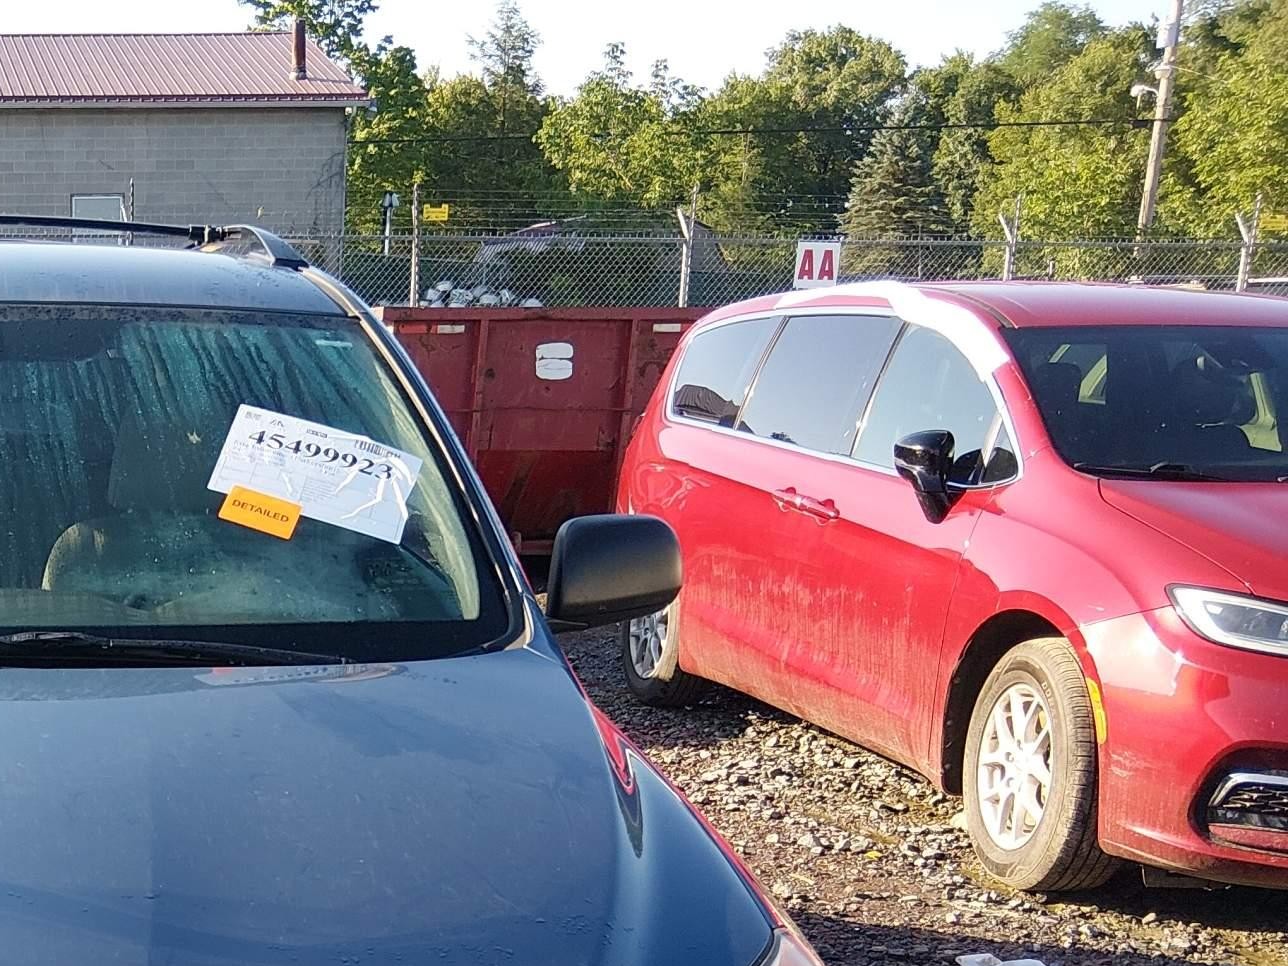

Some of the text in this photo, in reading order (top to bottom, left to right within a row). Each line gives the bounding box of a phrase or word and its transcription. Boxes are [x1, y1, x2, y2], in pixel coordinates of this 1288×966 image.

[797, 248, 834, 281] AA
[248, 429, 393, 481] 45499923
[231, 499, 290, 523] DETAILED
